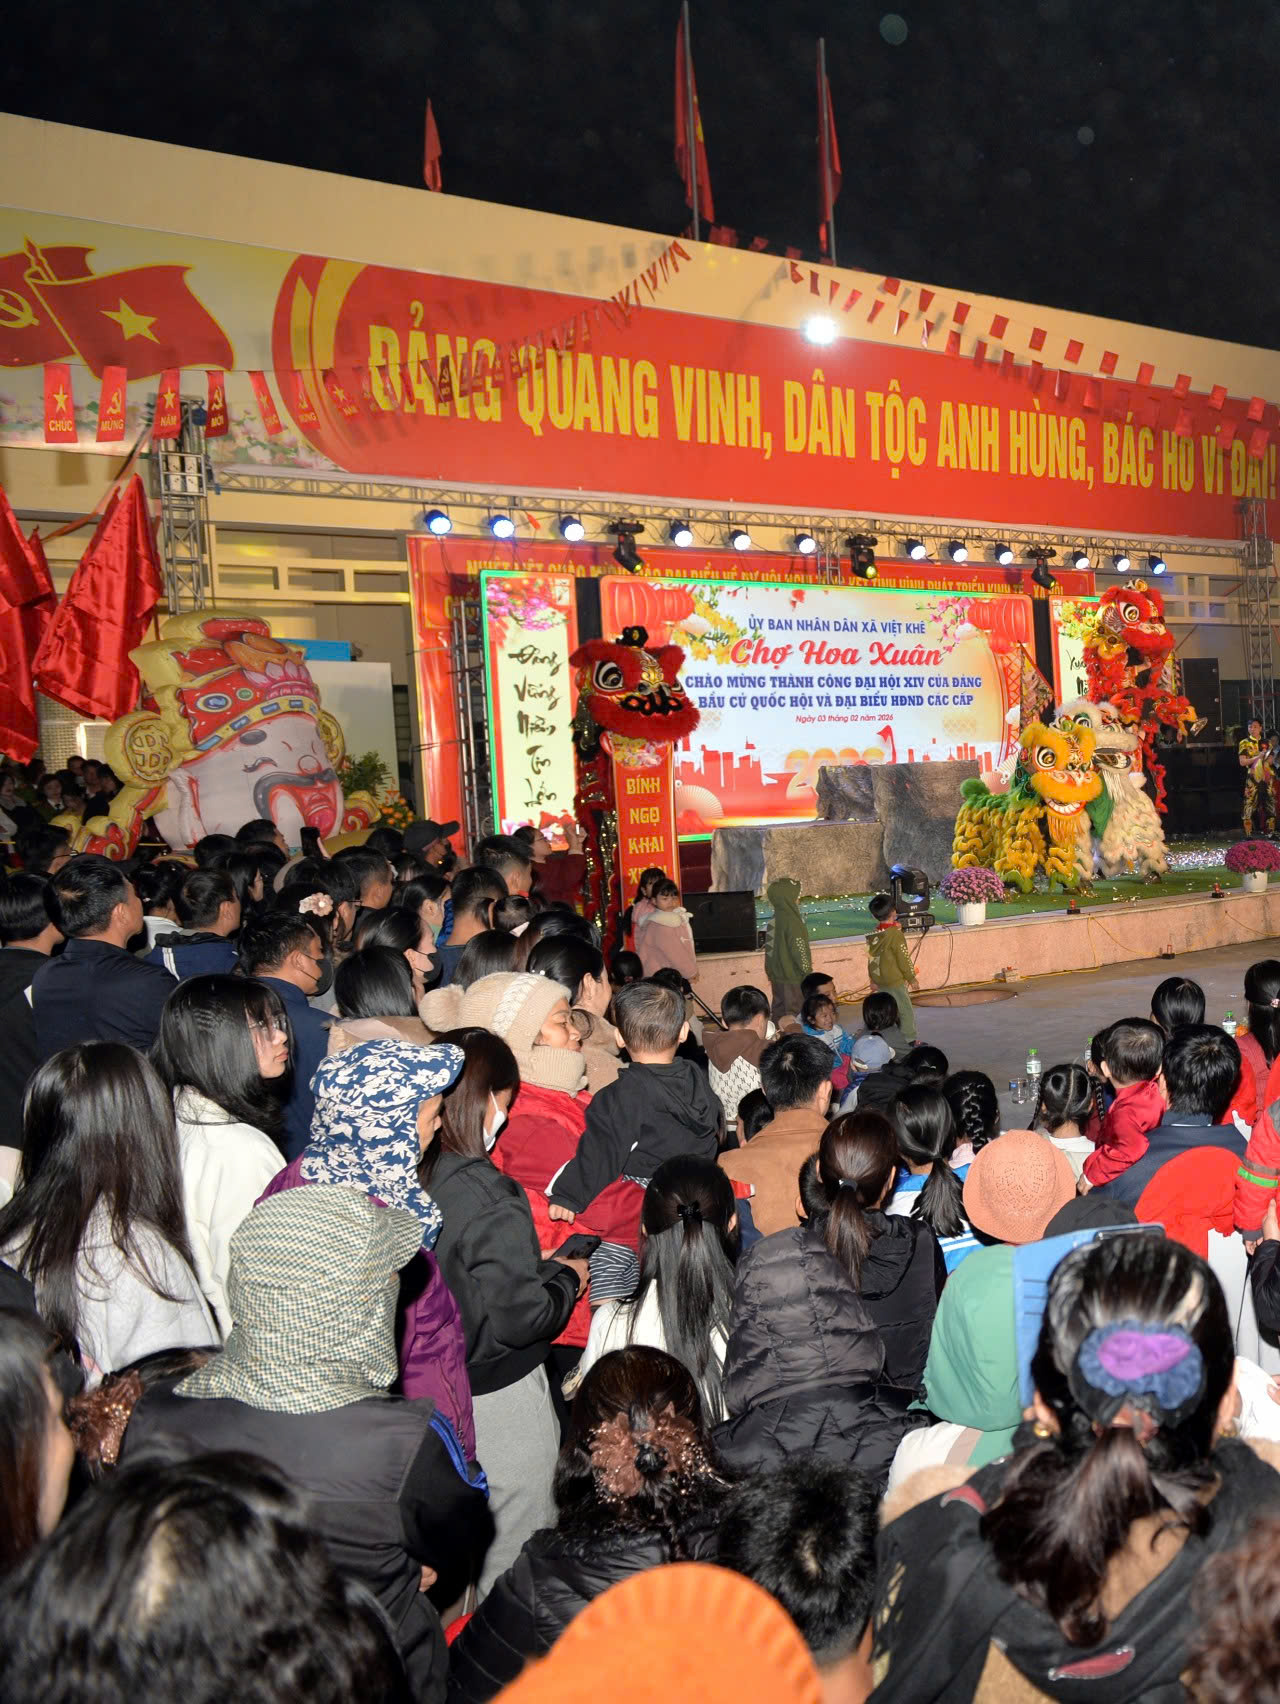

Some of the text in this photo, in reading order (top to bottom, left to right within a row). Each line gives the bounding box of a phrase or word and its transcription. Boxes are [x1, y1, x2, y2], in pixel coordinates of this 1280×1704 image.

[518, 345, 658, 436] QUANG
[670, 365, 772, 459] VINH,
[784, 368, 855, 458] DÂN
[866, 379, 927, 479] TỘC
[937, 401, 999, 472] ANH
[1009, 398, 1094, 490] HÙNG,
[1103, 411, 1153, 488] BÁC
[749, 614, 925, 636] ỦY BAN NHÂN DÂN XÃ VIỆT KHÊ
[730, 638, 944, 670] Chợ Hoa Xuân
[685, 673, 982, 690] CHÀO MỪNG THÀNH CÔNG ĐẠI HỘI XIV CỦA ĐẢNG
[698, 692, 725, 708] BẦU
[751, 692, 786, 710] QUỐC
[790, 693, 813, 710] HỘI
[816, 693, 832, 707] VÀ
[835, 695, 856, 709] ĐẠI
[860, 691, 887, 706] BIỂU
[891, 695, 924, 706] HĐND
[928, 693, 949, 706] CÁC
[952, 691, 973, 706] CẤP
[796, 715, 815, 724] Ngày
[828, 715, 848, 723] tháng
[526, 745, 551, 774] Tin
[626, 774, 660, 795] BÍNH
[630, 807, 660, 826] NGỌ
[628, 835, 664, 854] KHAI
